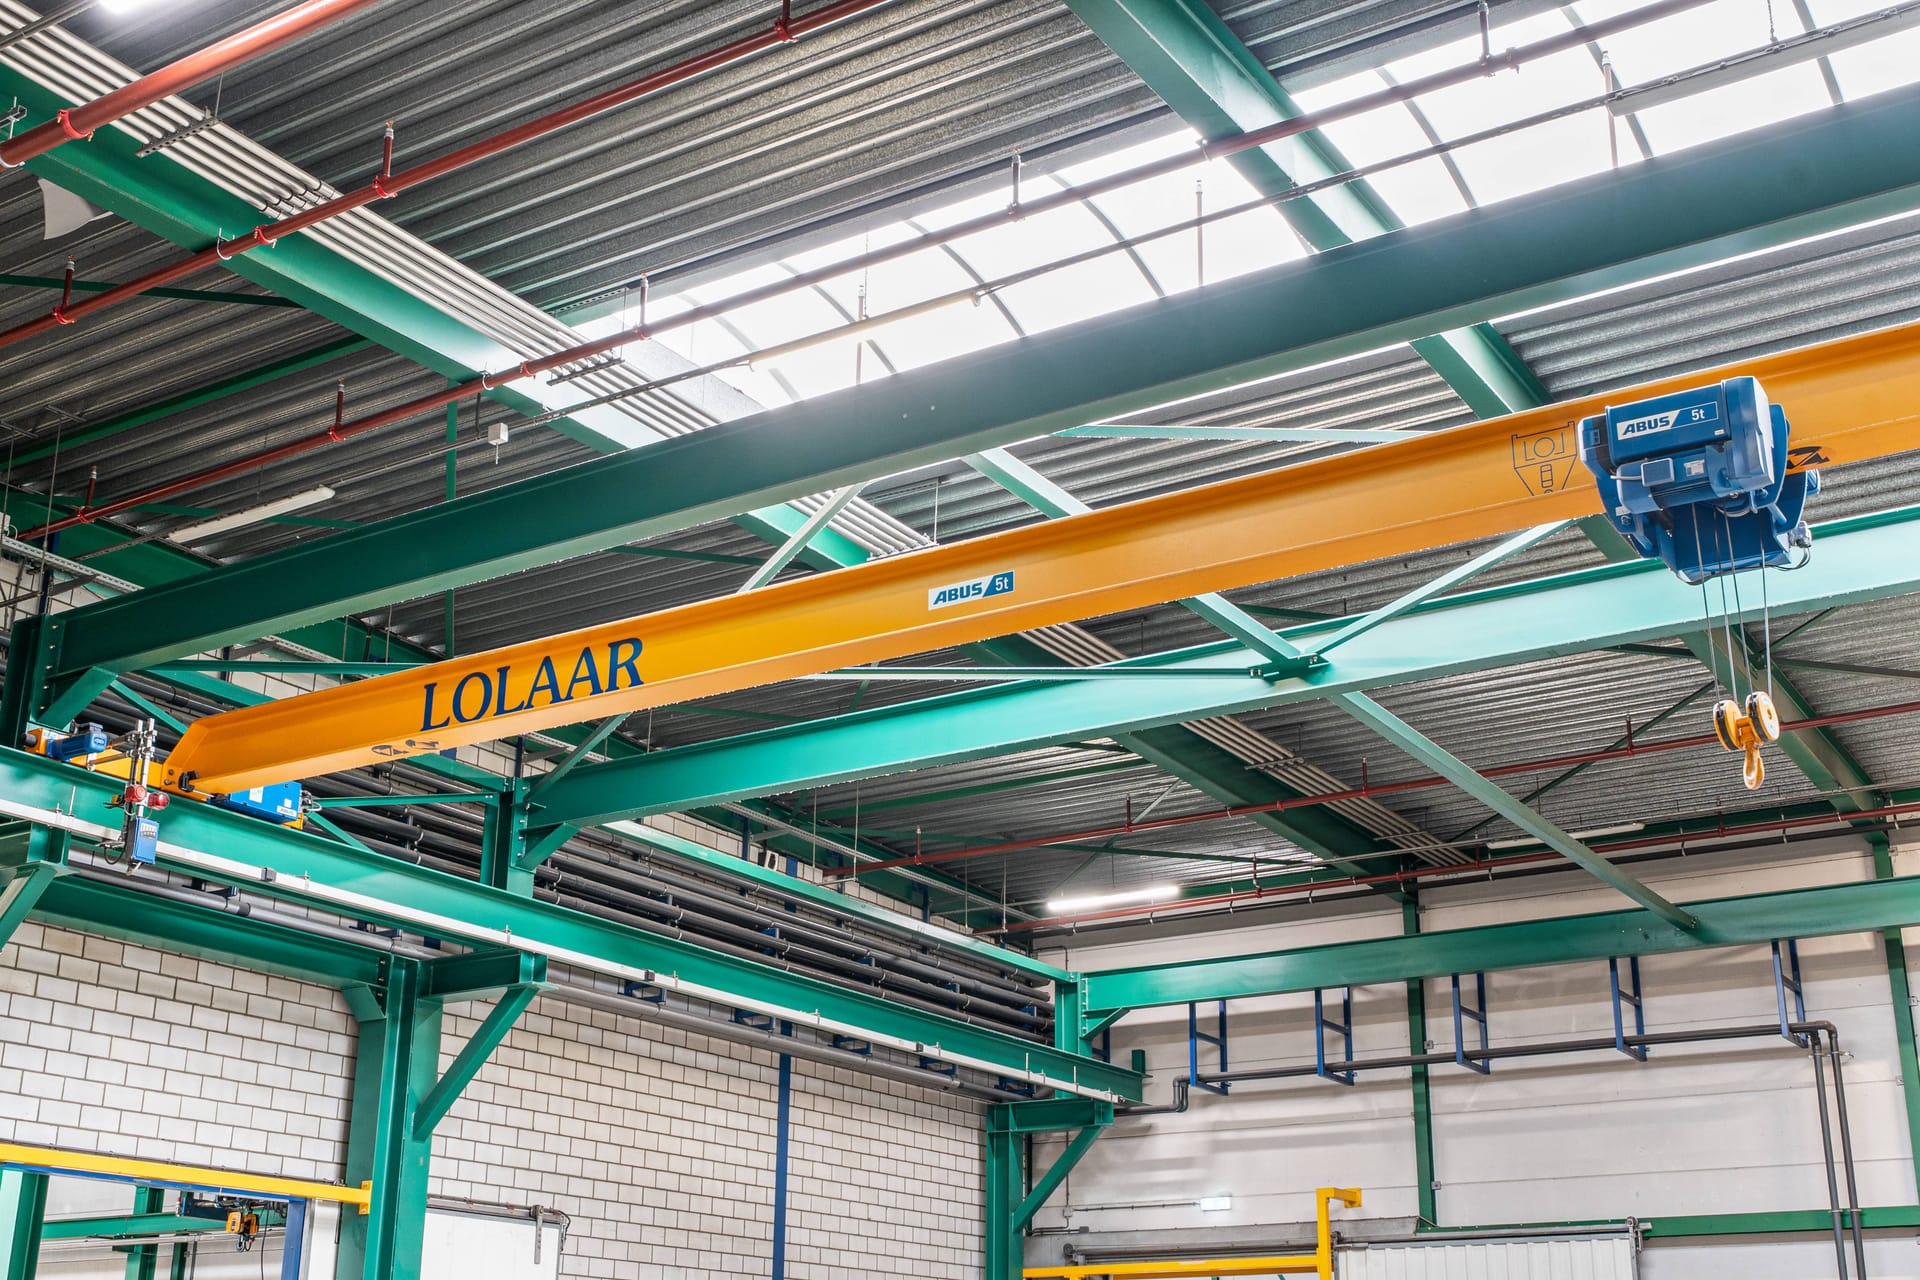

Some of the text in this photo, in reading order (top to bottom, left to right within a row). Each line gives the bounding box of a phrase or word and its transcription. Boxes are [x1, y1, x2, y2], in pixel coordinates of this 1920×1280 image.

[1622, 408, 1705, 436] ABUS 5t
[933, 576, 1009, 605] ABUS 5t
[420, 636, 645, 732] LOLAAR
